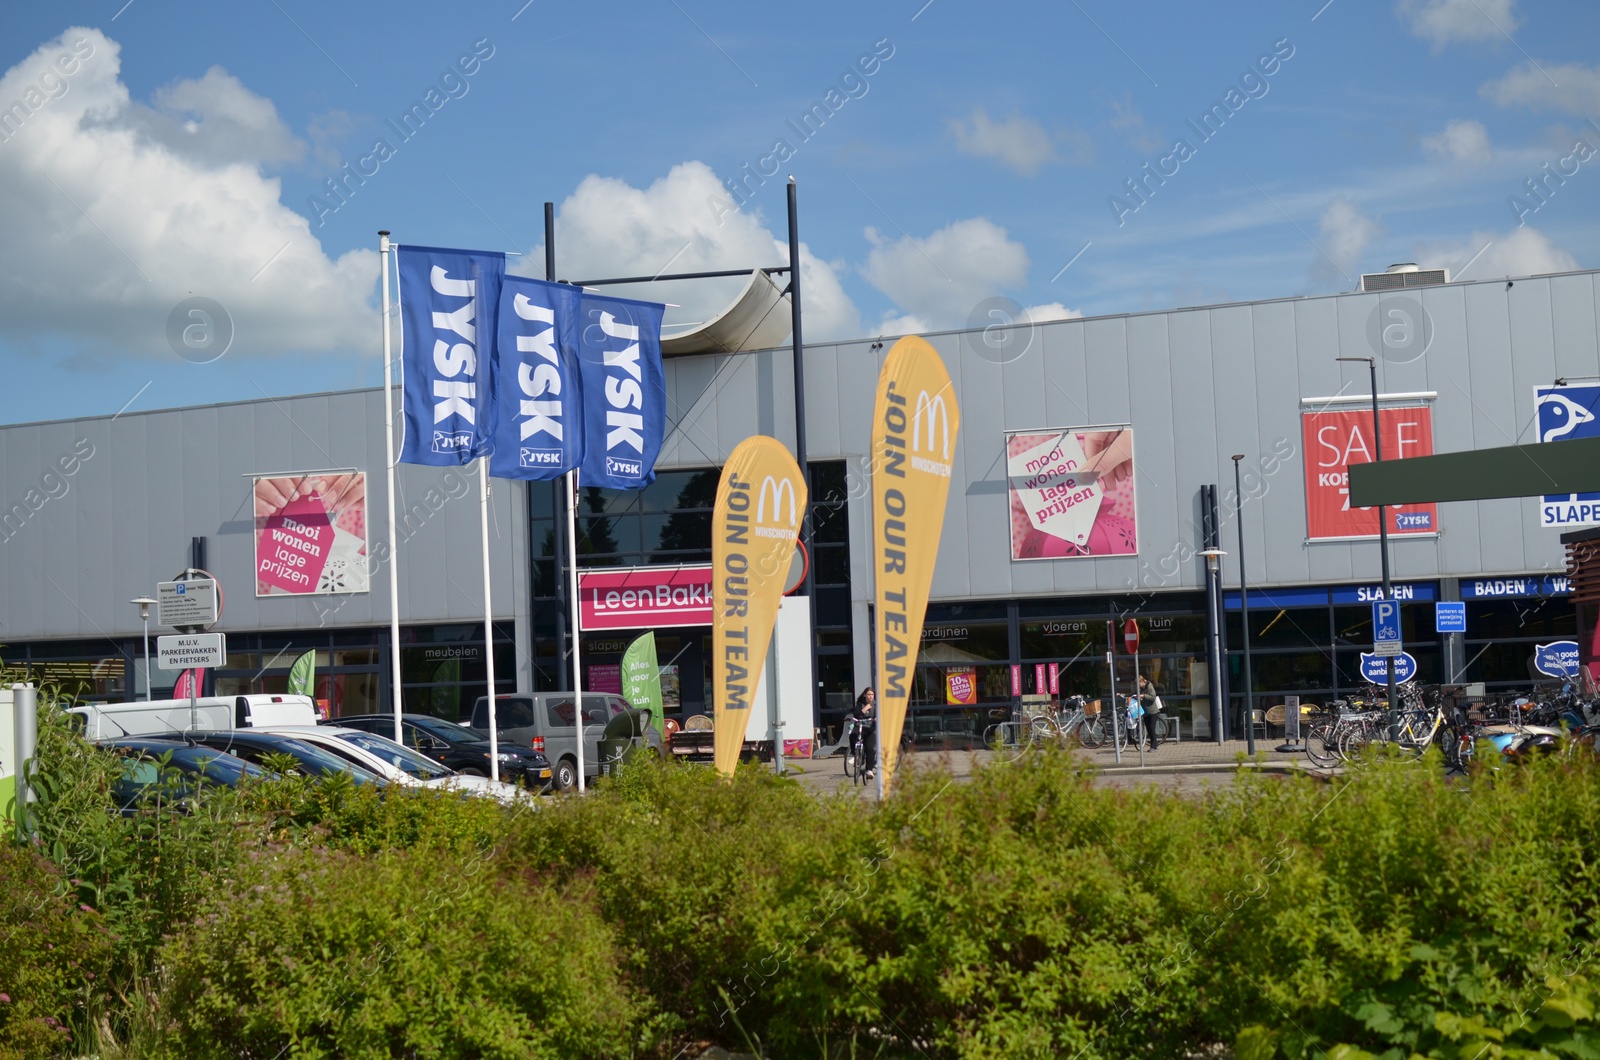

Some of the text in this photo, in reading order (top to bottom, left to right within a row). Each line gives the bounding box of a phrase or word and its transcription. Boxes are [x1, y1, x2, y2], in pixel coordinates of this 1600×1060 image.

[430, 264, 476, 426] JYSK
[514, 292, 563, 442] JYSK
[600, 310, 644, 454] JYSK
[885, 381, 907, 479] JOIN
[442, 434, 470, 448] JYSK
[1318, 422, 1418, 467] SAE
[528, 452, 560, 463] JYSK
[612, 462, 640, 474] JYSK
[911, 455, 952, 478] WINSCHOTEN
[1026, 446, 1064, 473] mooi
[1024, 460, 1078, 490] wonen
[1038, 478, 1076, 502] lage
[726, 472, 750, 544] JOIN
[1036, 487, 1094, 524] prijzen
[282, 518, 320, 540] mooi
[1402, 515, 1430, 525] JYSK
[755, 526, 796, 540] WINSCHOTEN
[884, 488, 907, 575] OUR
[272, 529, 320, 556] wonen
[275, 546, 306, 568] lage
[260, 558, 310, 586] prijzen
[725, 553, 748, 618] OUR
[1358, 585, 1413, 602] SLAEN
[1475, 580, 1525, 596] BADEN
[1150, 617, 1172, 628] tuin
[1378, 604, 1393, 624] P
[1043, 621, 1087, 632] vloeren
[161, 647, 217, 656] PARKEERVAKKEN
[425, 646, 478, 658] meubelen
[588, 640, 626, 652] slapen
[885, 587, 908, 698] TEAM
[630, 661, 650, 671] Alles
[725, 626, 748, 710] TEAM
[1368, 667, 1408, 676] aanbiing!
[630, 674, 650, 682] voor
[950, 676, 968, 686] 10%
[632, 686, 640, 696] je
[633, 696, 650, 705] tuin
